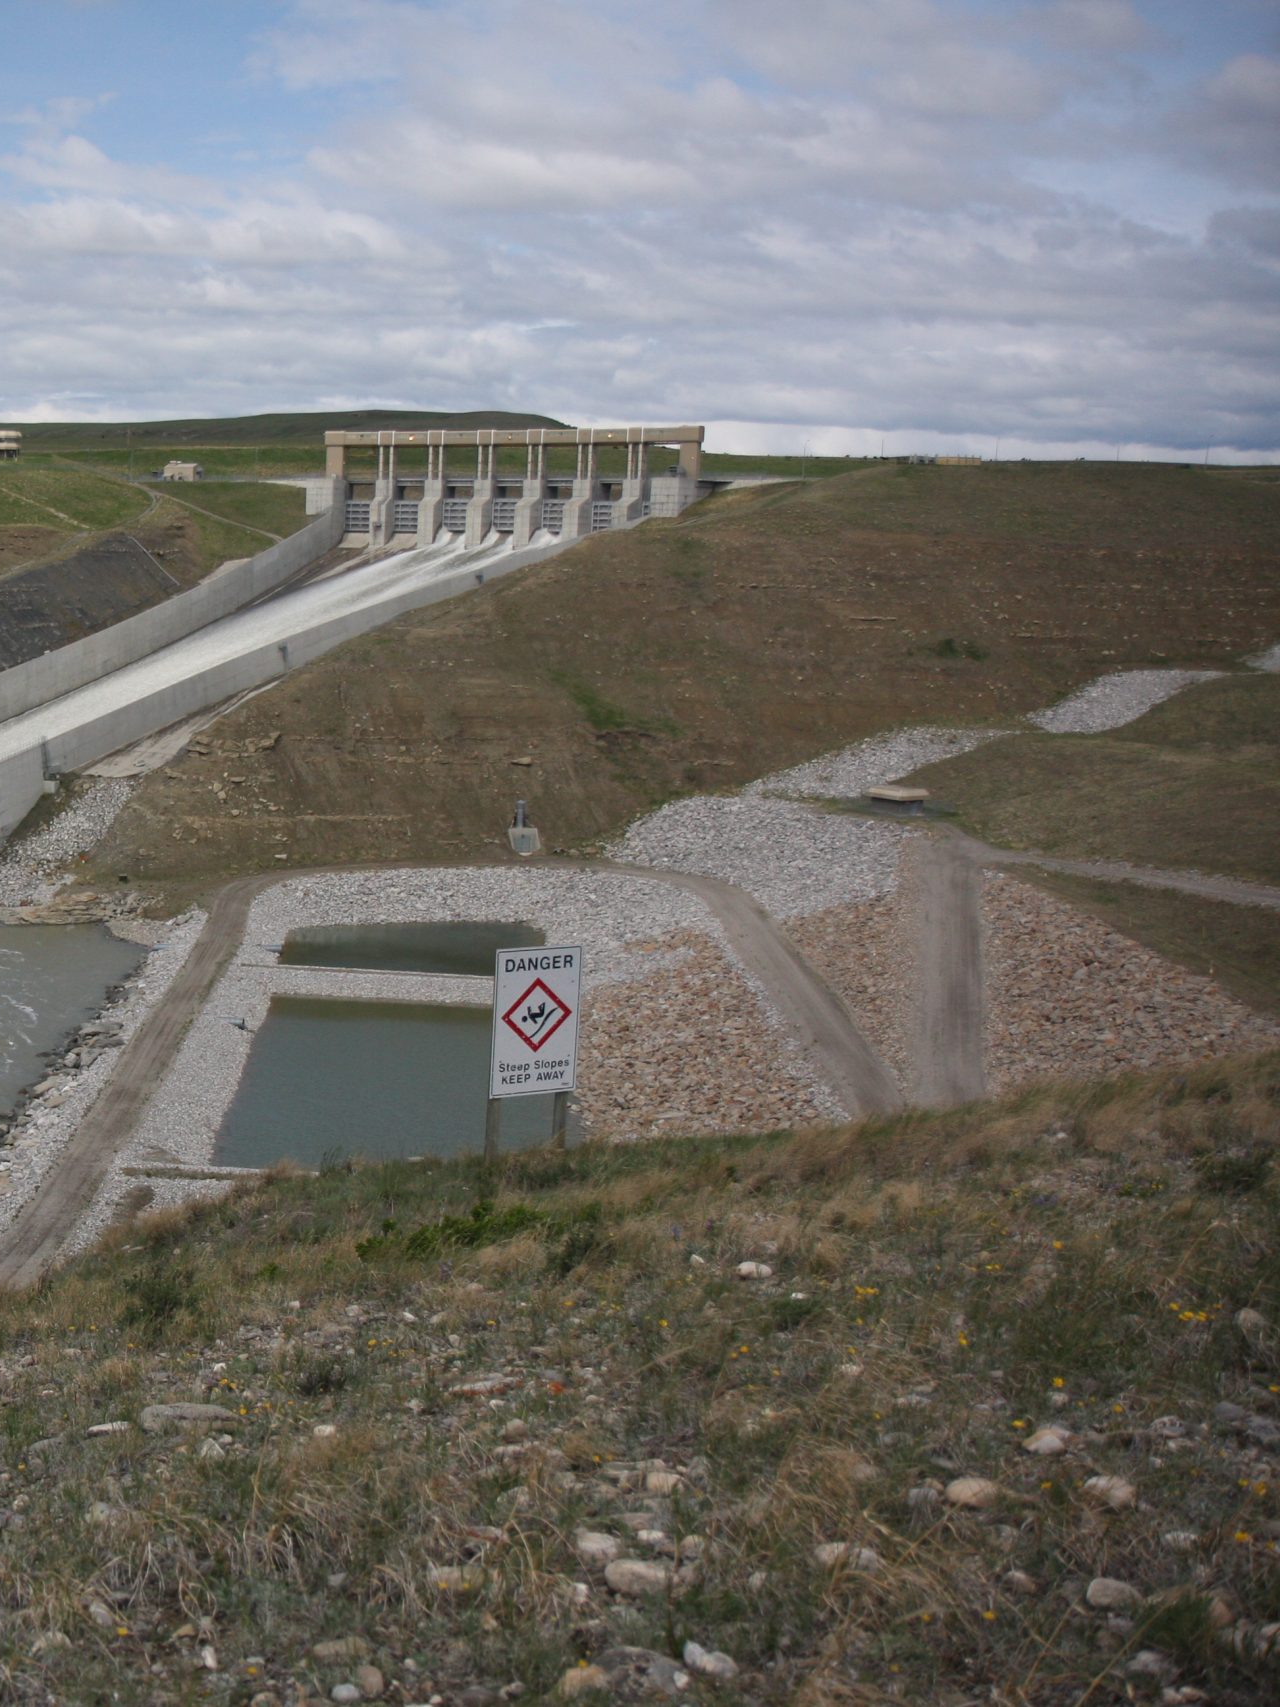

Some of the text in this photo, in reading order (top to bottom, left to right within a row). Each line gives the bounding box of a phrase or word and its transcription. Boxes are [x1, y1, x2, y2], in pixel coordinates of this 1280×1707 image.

[505, 954, 573, 973] DANGER
[498, 1059, 569, 1073] Steep Slopes
[501, 1070, 565, 1085] KEEP AWAY
